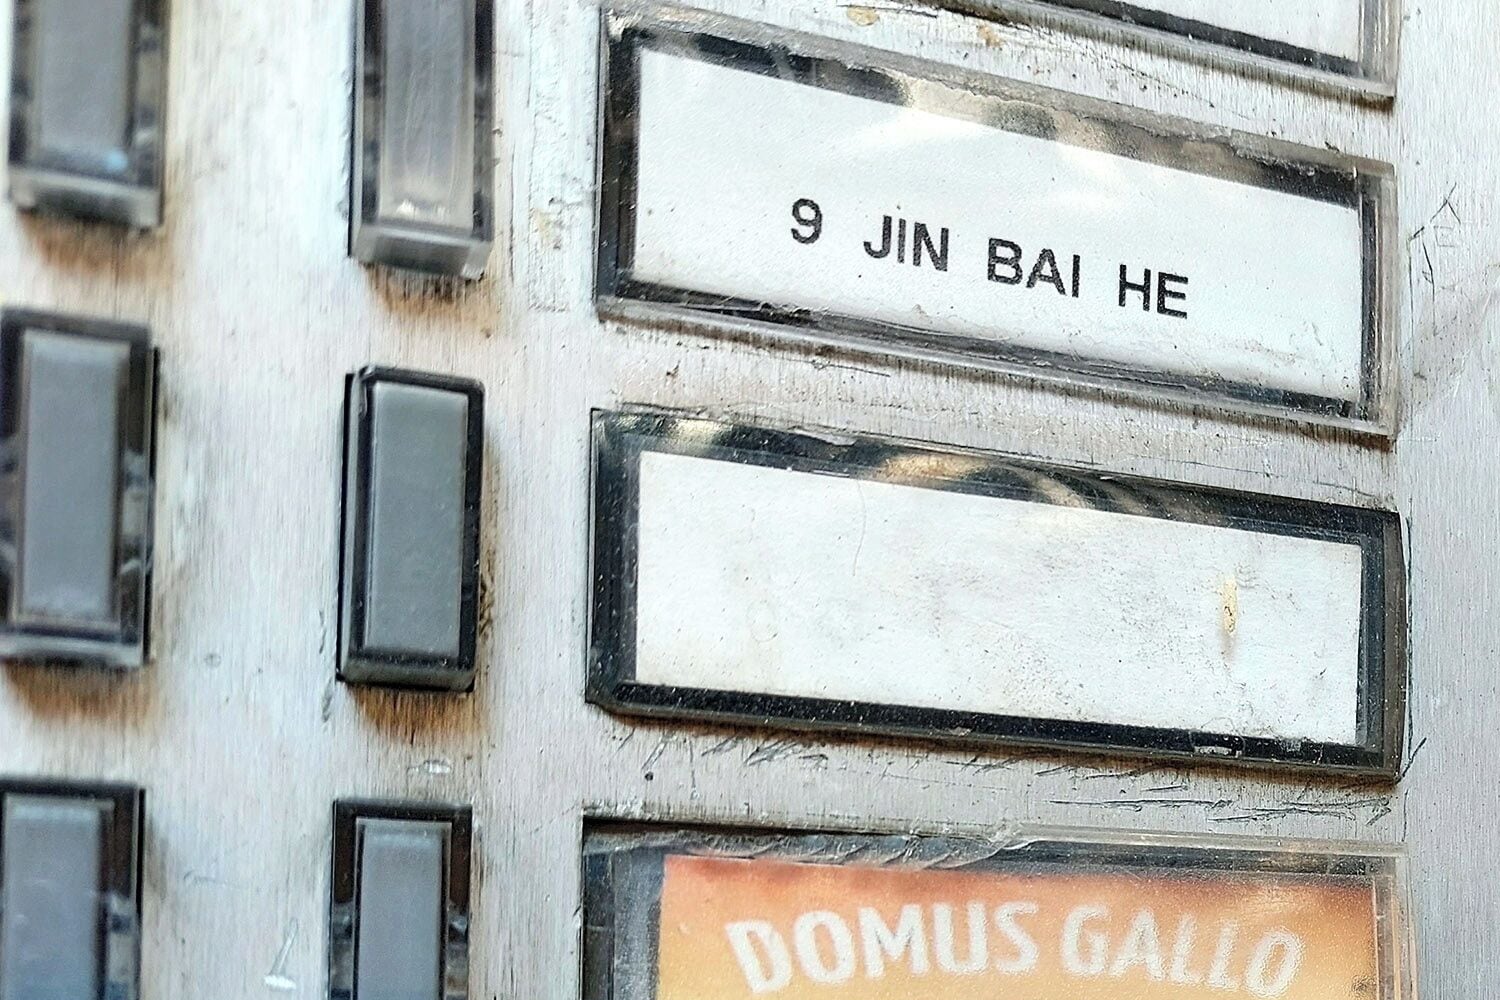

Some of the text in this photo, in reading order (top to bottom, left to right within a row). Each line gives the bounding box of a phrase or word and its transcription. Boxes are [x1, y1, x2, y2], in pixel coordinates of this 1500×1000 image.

[790, 198, 1189, 319] 9 JIN BAI HE
[725, 900, 1304, 1000] DOMUS GALLO
